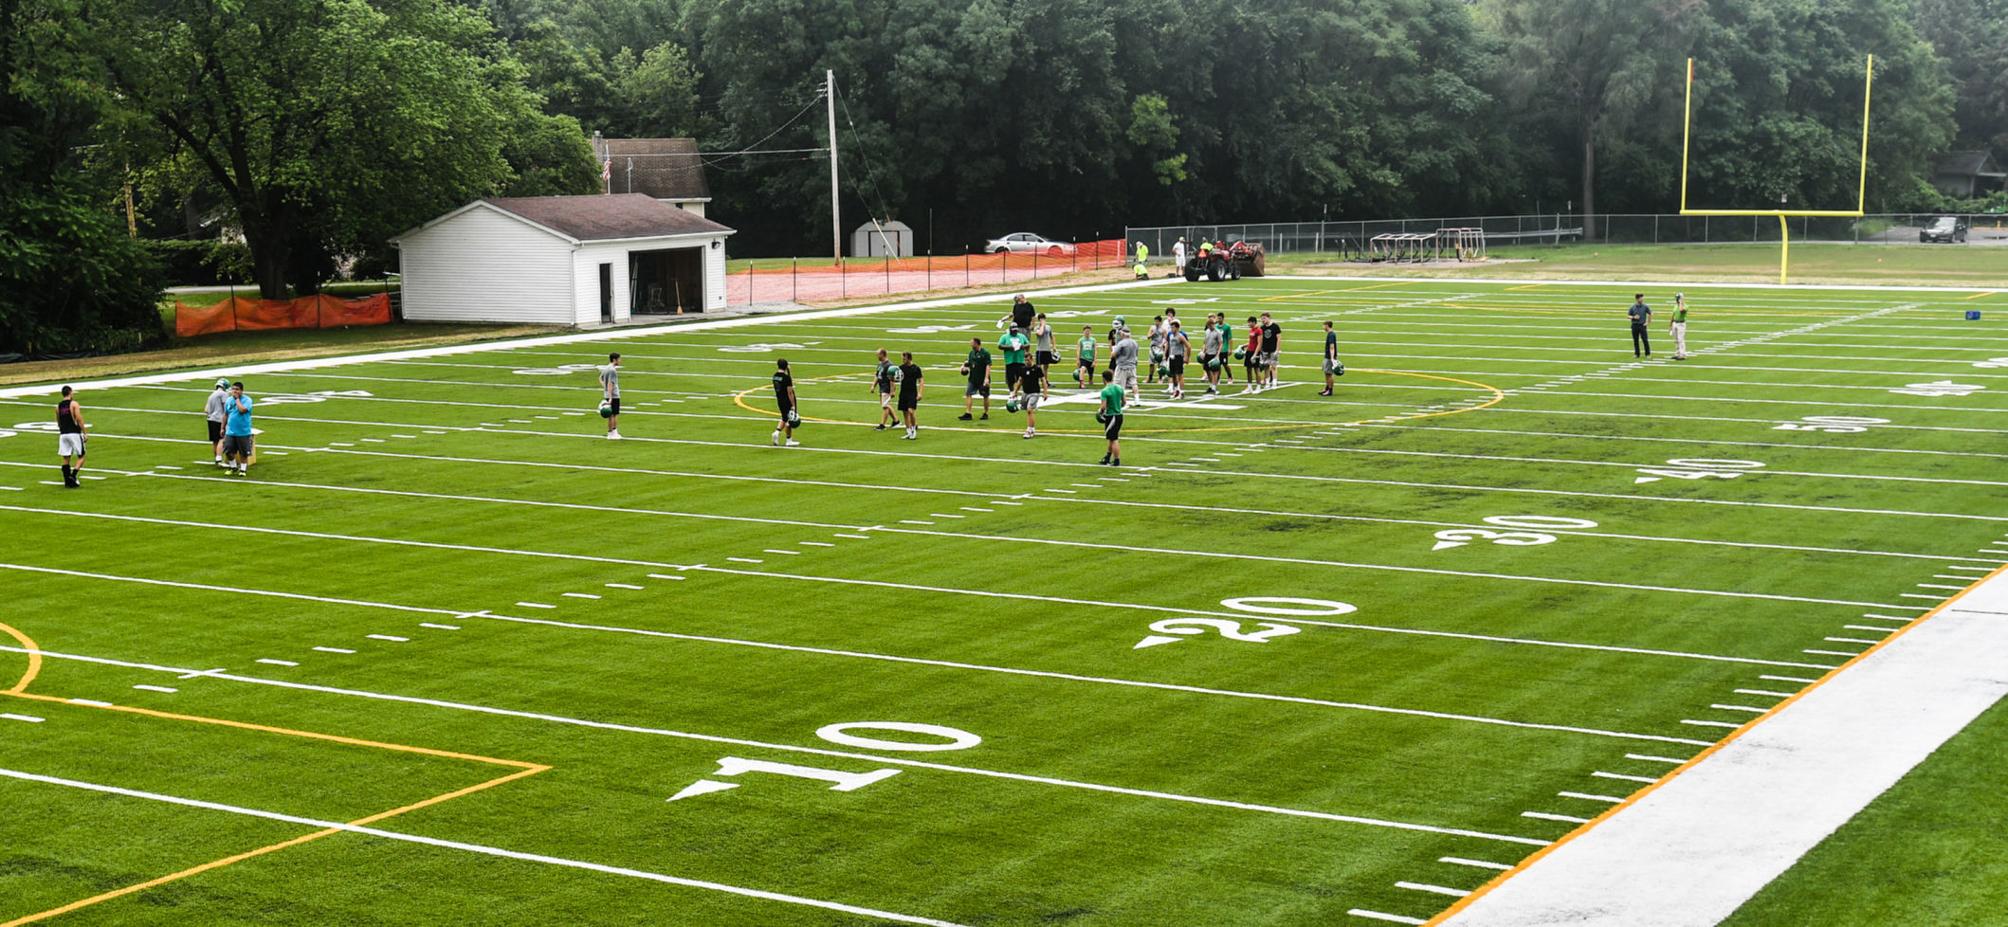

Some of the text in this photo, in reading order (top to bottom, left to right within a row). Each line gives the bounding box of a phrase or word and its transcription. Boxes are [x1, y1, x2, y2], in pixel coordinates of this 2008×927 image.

[1772, 415, 1892, 433] 50
[1636, 457, 1765, 480] 40
[1433, 514, 1599, 547] 30
[1148, 596, 1358, 644] 20
[712, 720, 982, 793] 10
